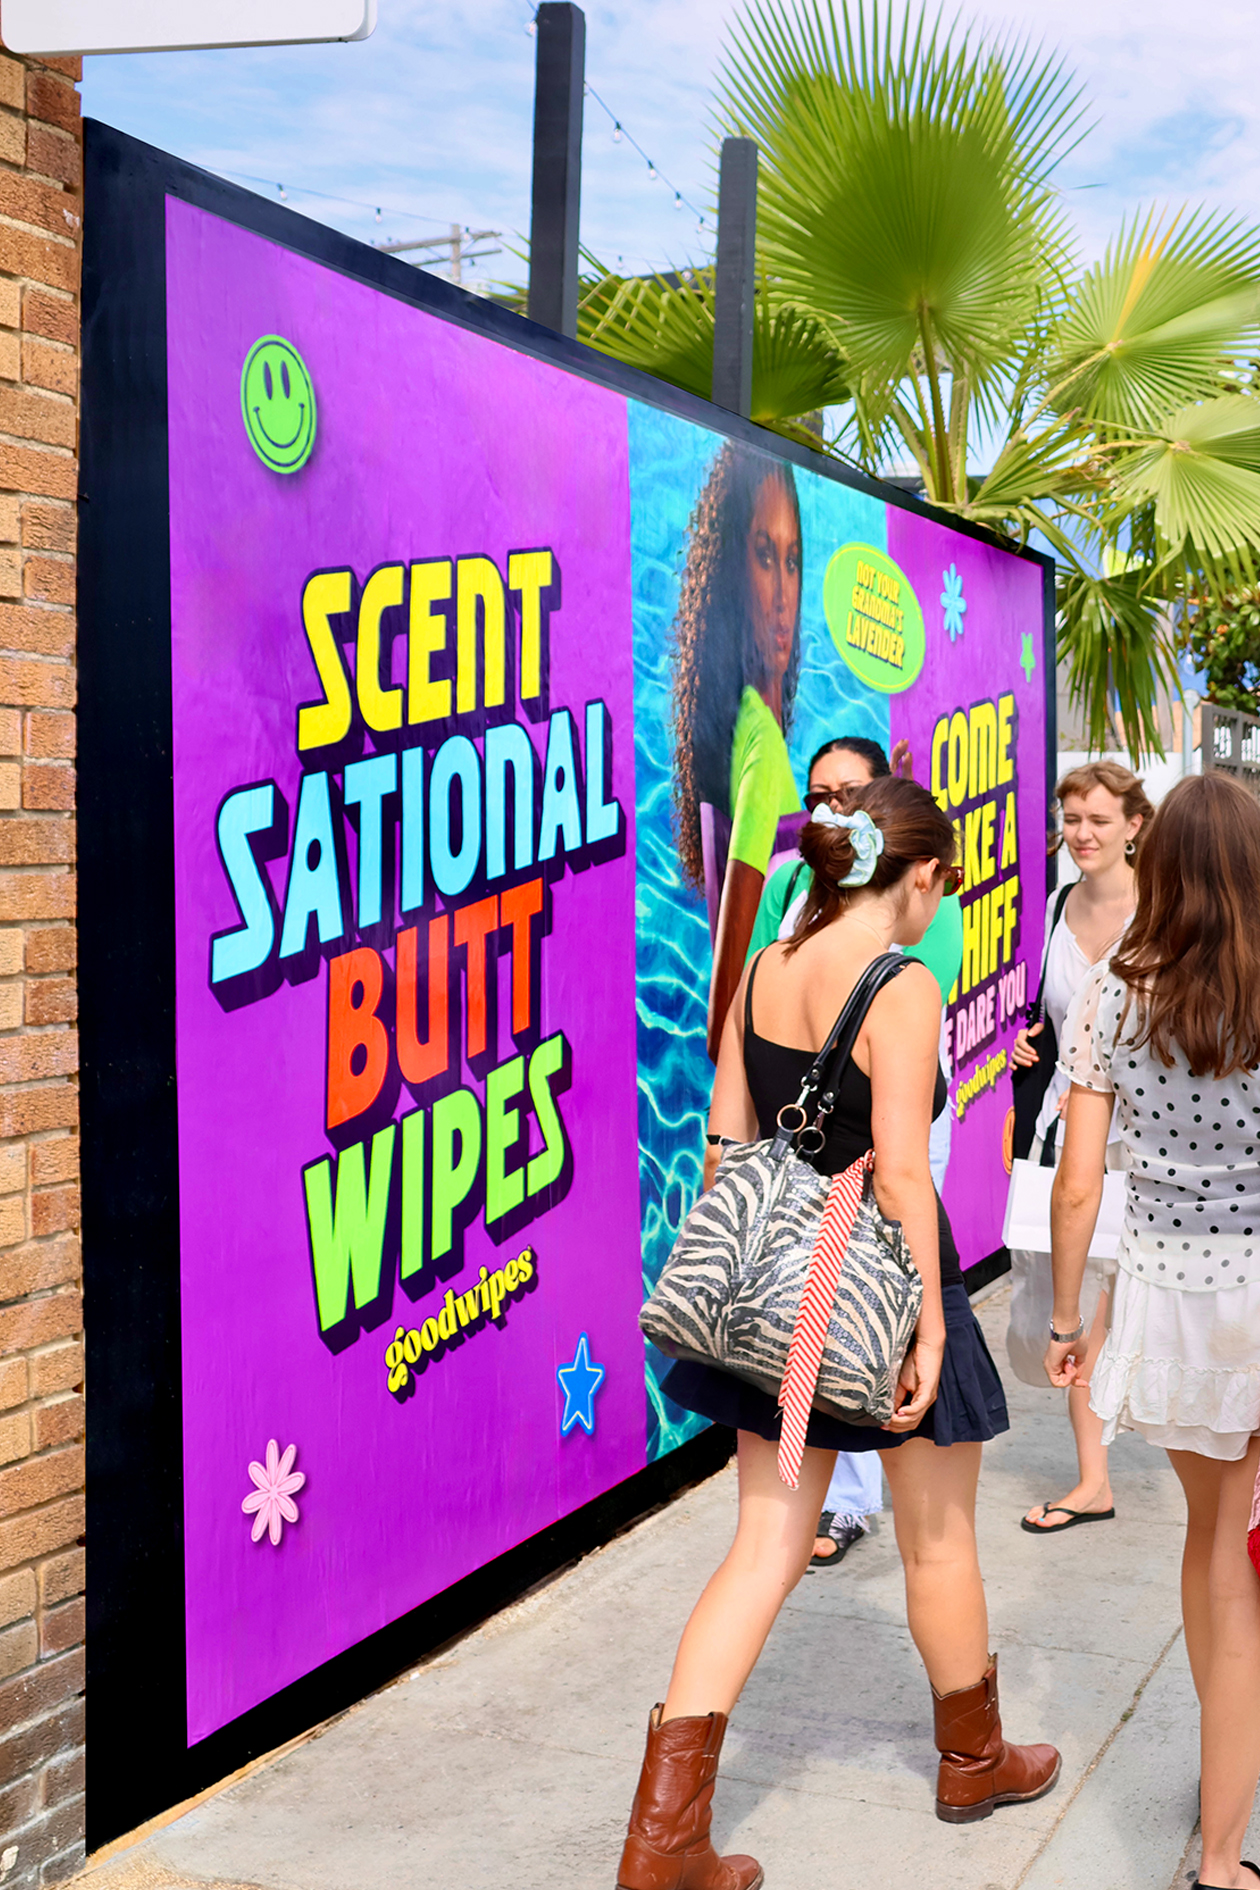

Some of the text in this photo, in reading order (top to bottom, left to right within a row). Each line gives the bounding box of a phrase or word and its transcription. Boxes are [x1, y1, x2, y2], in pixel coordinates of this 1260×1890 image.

[845, 611, 906, 670] LAVENDER
[851, 585, 904, 635] GRANDMA'S
[856, 560, 901, 607] NOT YOUR
[297, 548, 558, 755] SCENT
[930, 691, 1016, 814] COME
[209, 700, 622, 987] SATIONAL
[1000, 791, 1018, 871] A
[949, 874, 1020, 1006] HIFF
[324, 876, 546, 1133] BUTT
[943, 960, 1027, 1068] E DARE YOU
[955, 1047, 1008, 1119] goodwipes
[302, 1032, 568, 1335] WIPES
[384, 1246, 537, 1396] goodwipes
